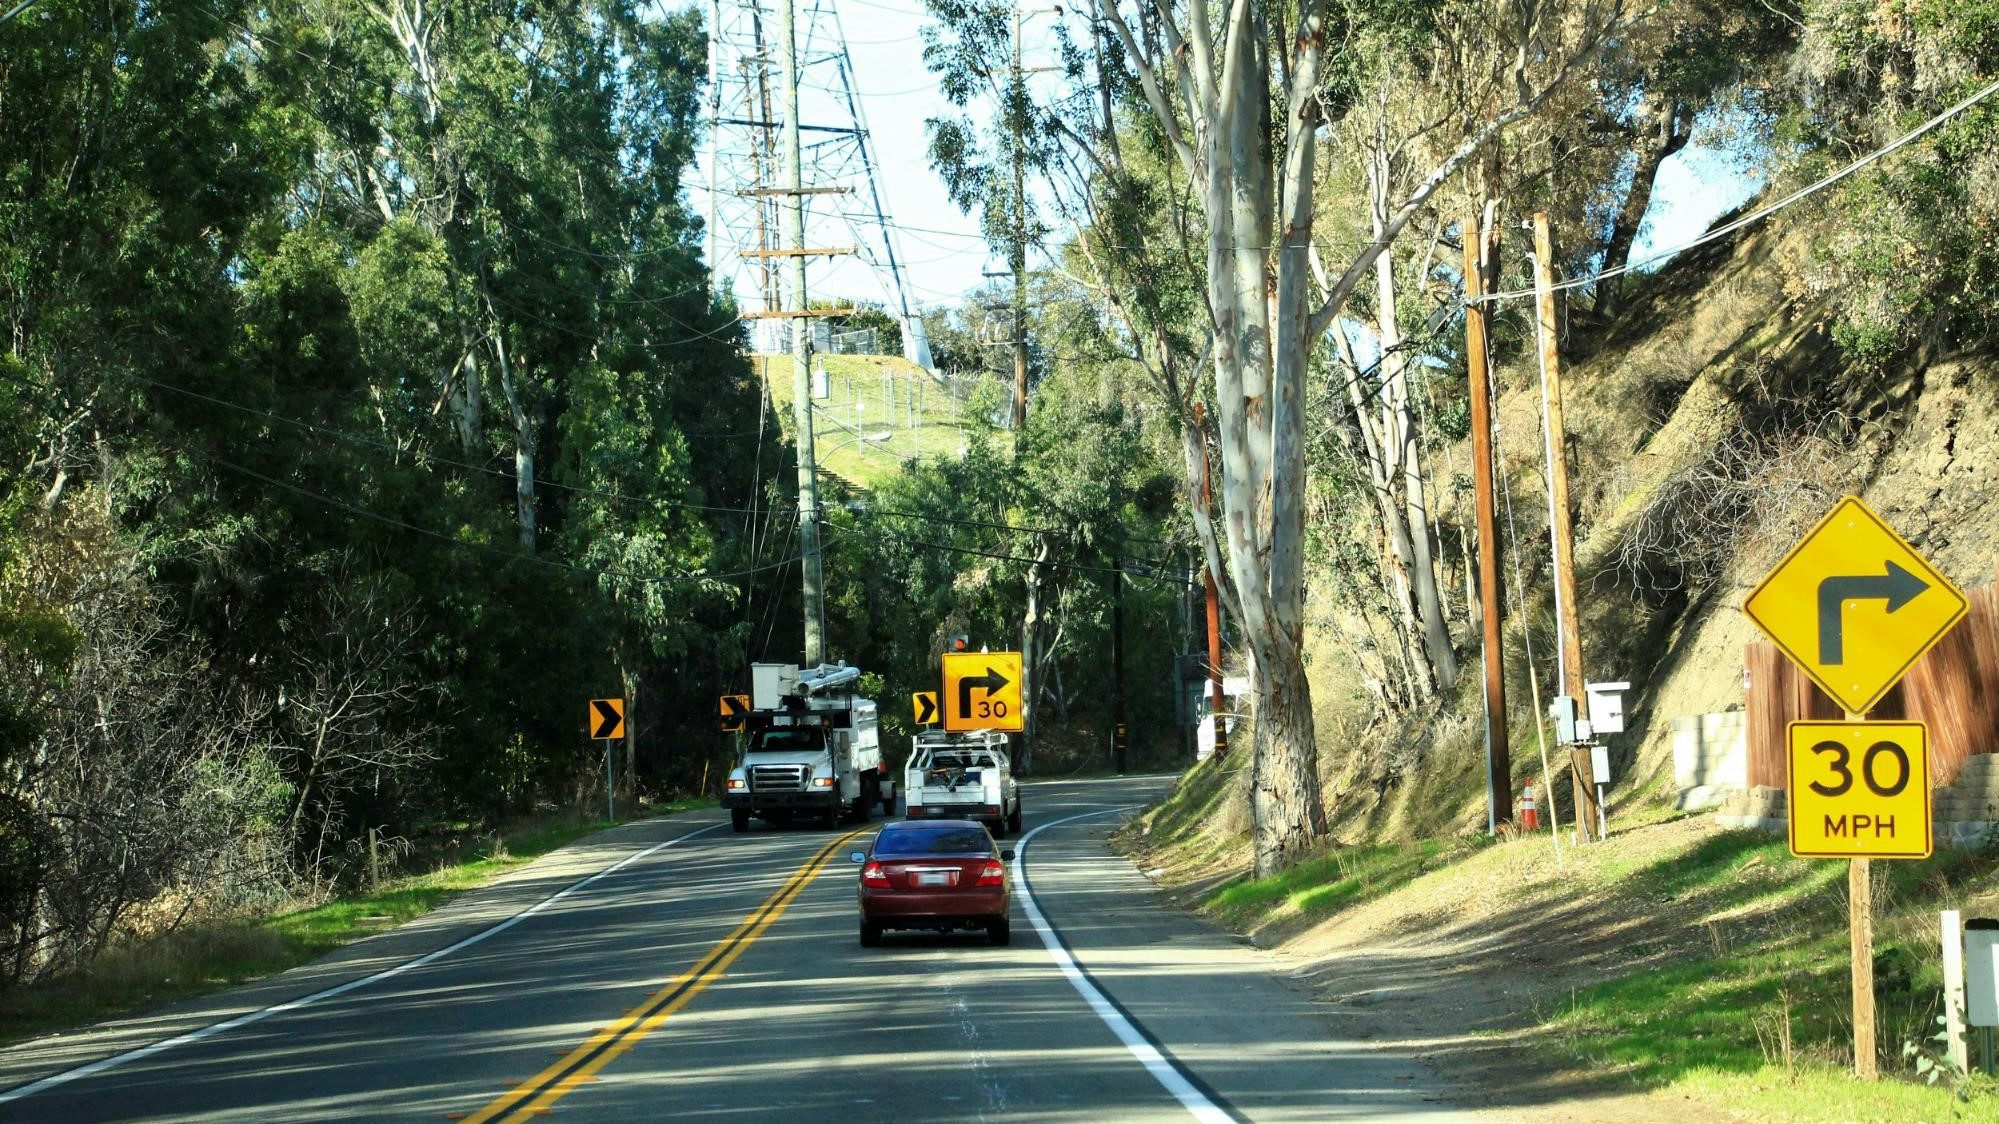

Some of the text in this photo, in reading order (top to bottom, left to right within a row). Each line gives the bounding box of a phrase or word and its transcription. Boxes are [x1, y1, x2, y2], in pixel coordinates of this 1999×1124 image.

[978, 701, 1007, 718] 30
[1809, 741, 1910, 797] 30
[1824, 814, 1895, 838] MPH
